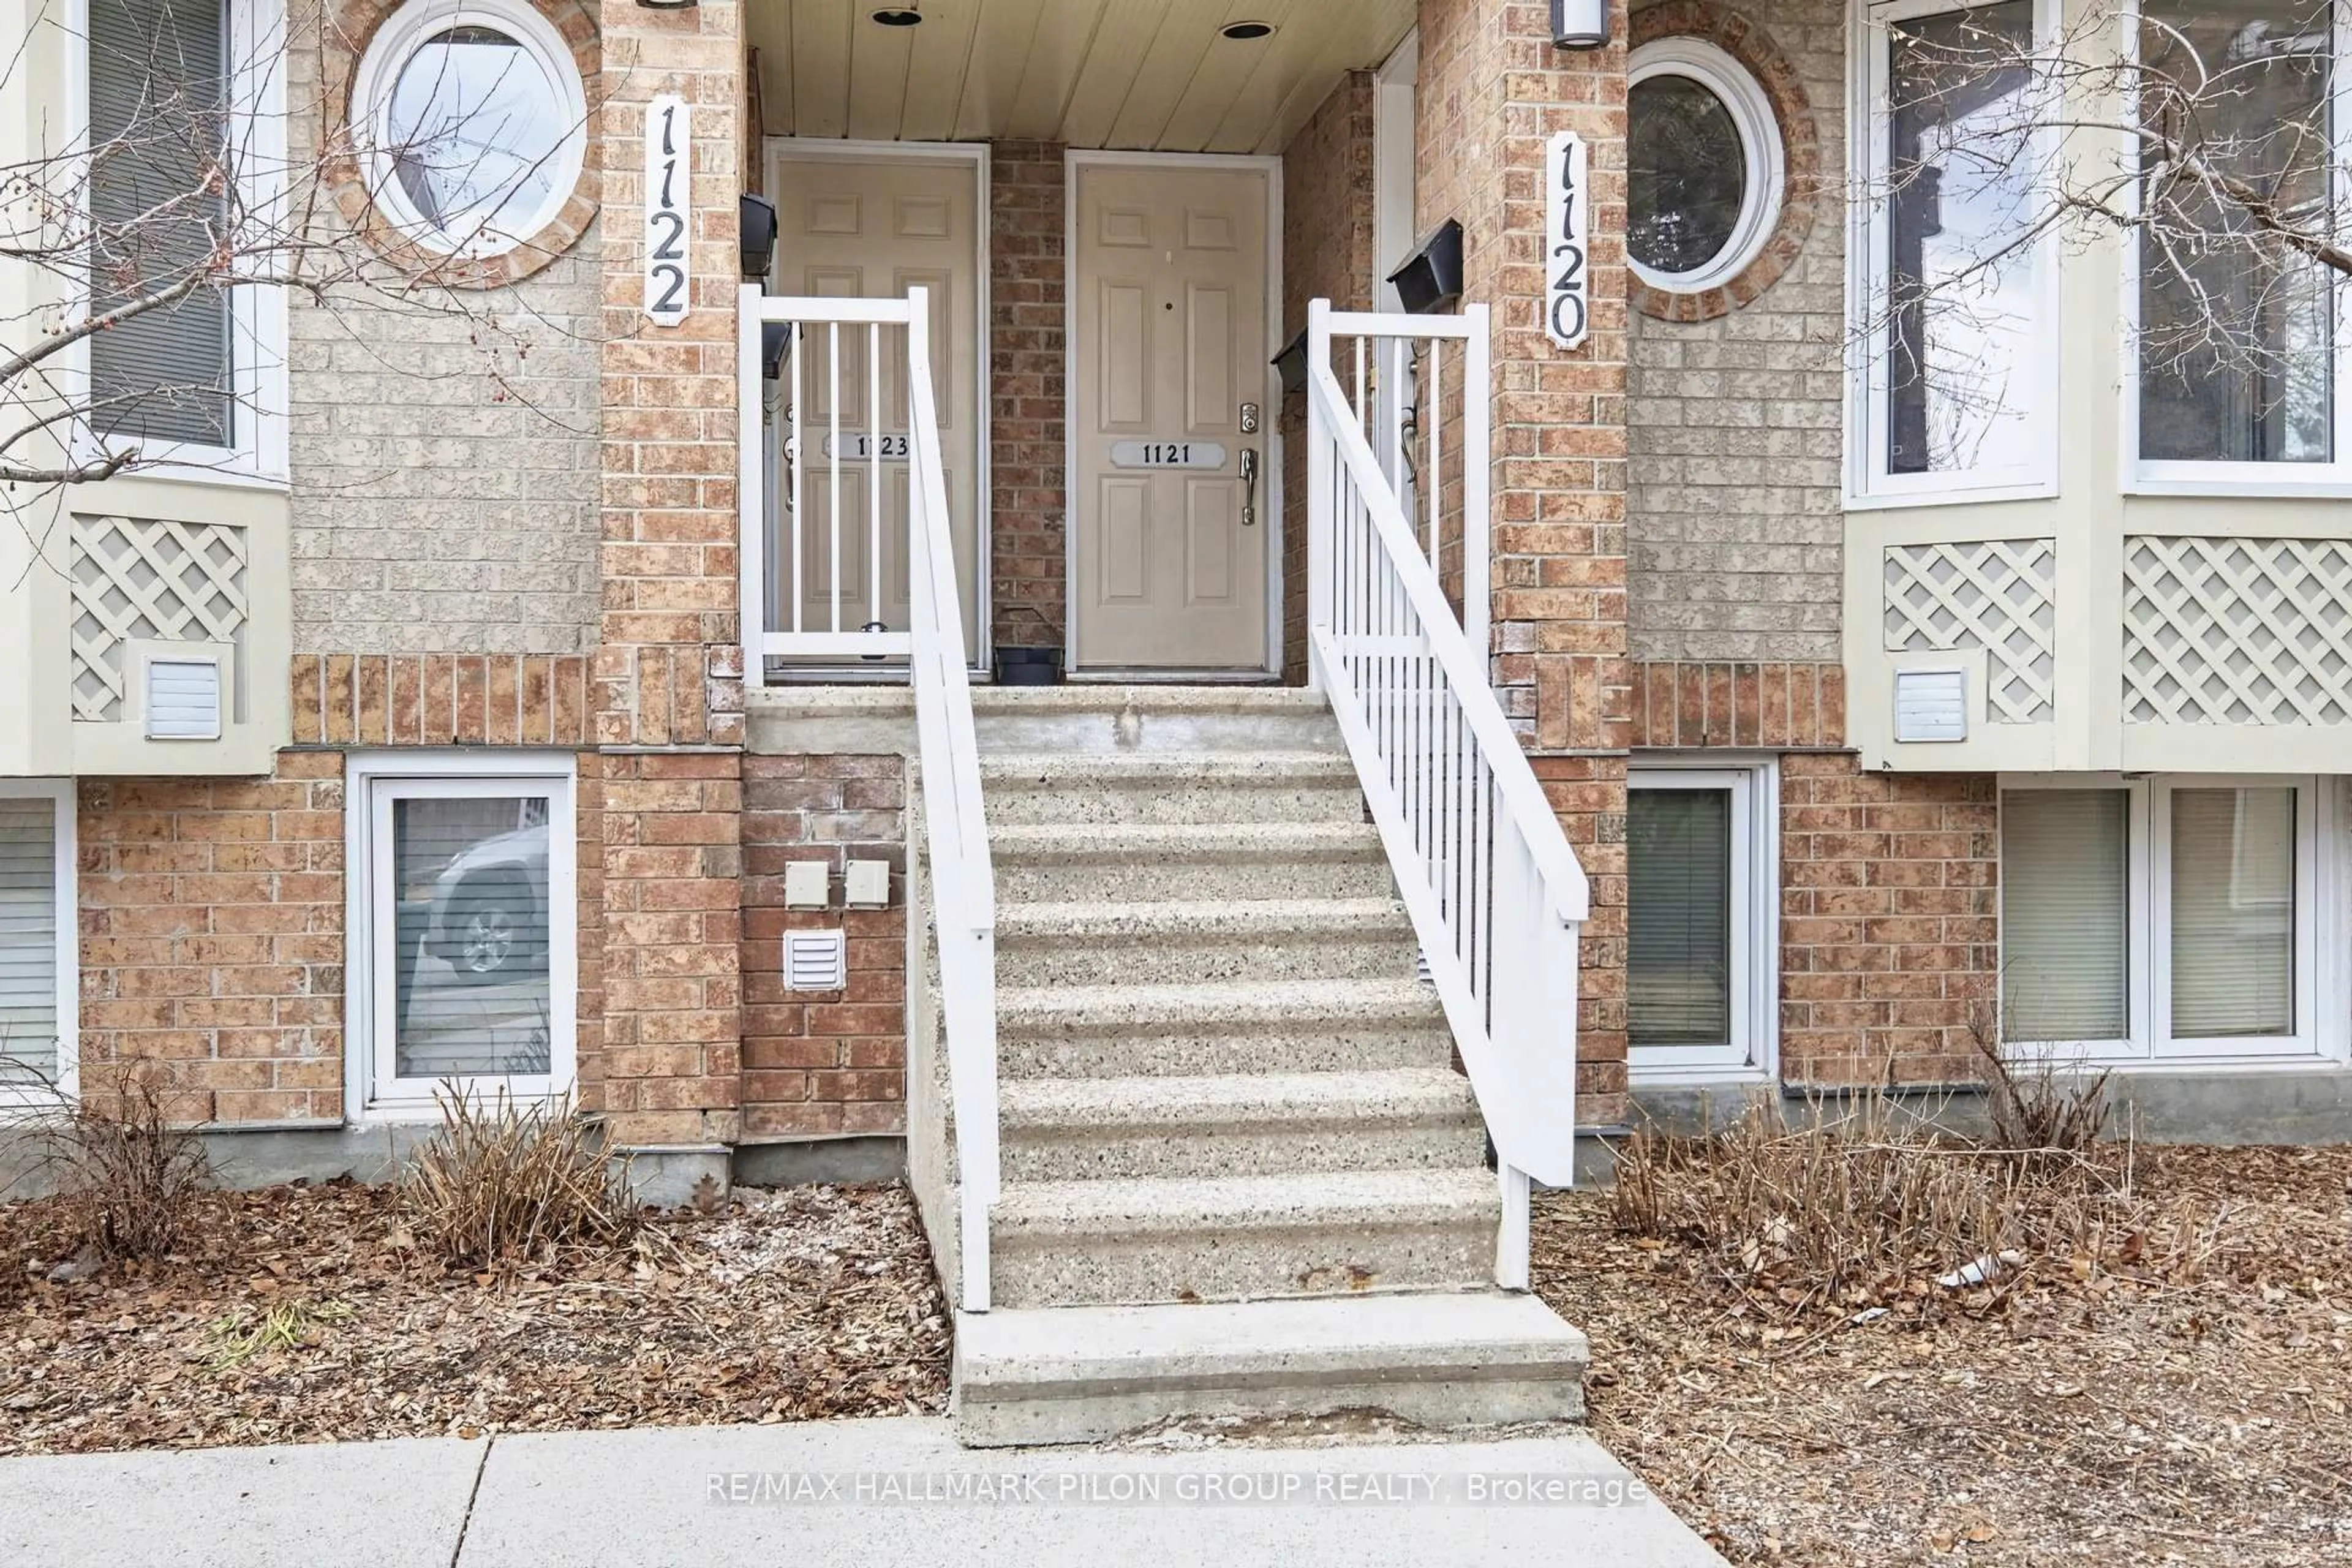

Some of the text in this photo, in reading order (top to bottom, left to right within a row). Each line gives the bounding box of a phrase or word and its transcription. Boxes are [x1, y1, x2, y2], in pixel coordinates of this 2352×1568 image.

[650, 105, 684, 312] 1122
[1551, 142, 1585, 339] 1120
[858, 437, 908, 456] 123
[1144, 444, 1189, 463] 1121
